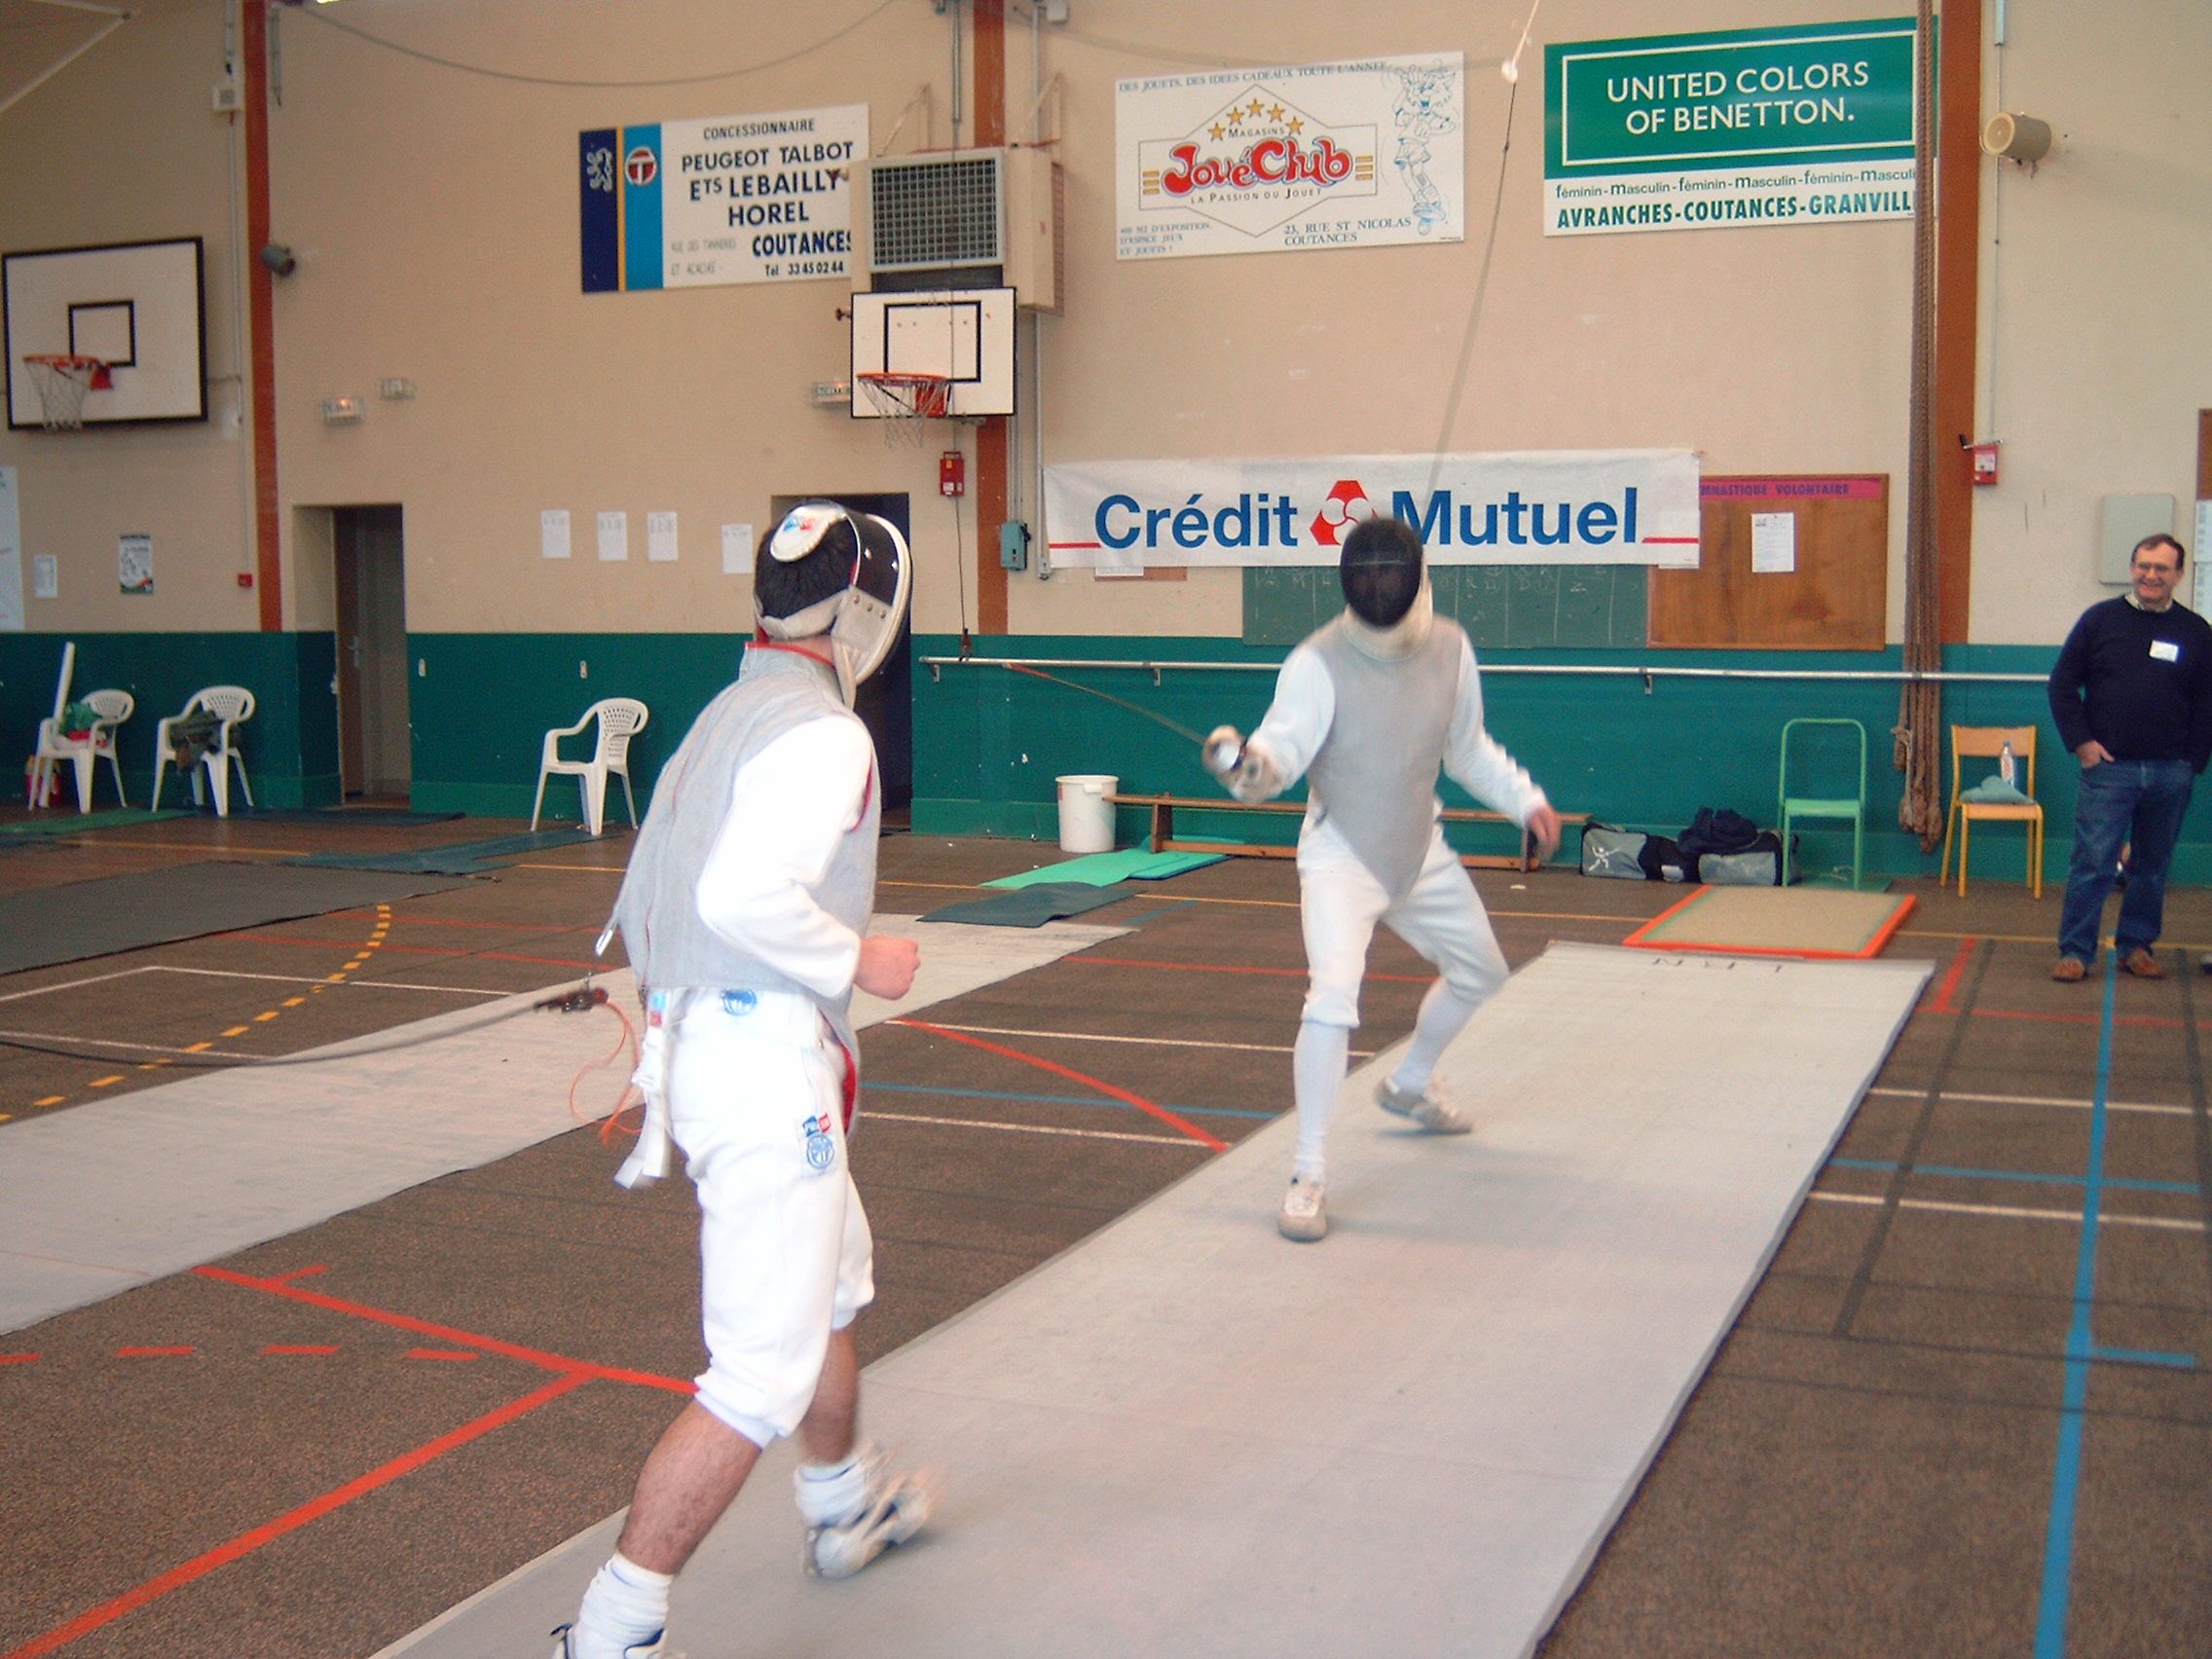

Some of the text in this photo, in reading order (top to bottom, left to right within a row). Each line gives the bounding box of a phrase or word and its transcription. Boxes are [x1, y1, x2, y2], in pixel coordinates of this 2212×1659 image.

[1607, 61, 1869, 102] UNITED COLORS
[703, 118, 815, 141] CONCESSIONNAIRE
[1626, 97, 1855, 135] OF BENETTON.
[682, 141, 854, 172] PEUGEOT TALBOT
[729, 167, 841, 198] LEBAILLY
[728, 201, 809, 227] HOREL
[1306, 223, 1330, 234] RUE
[1336, 221, 1350, 232] ST
[1357, 217, 1412, 230] NICOLAS
[1284, 232, 1357, 246] COUTANCES
[1094, 487, 1638, 549] Crédit Mutuel
